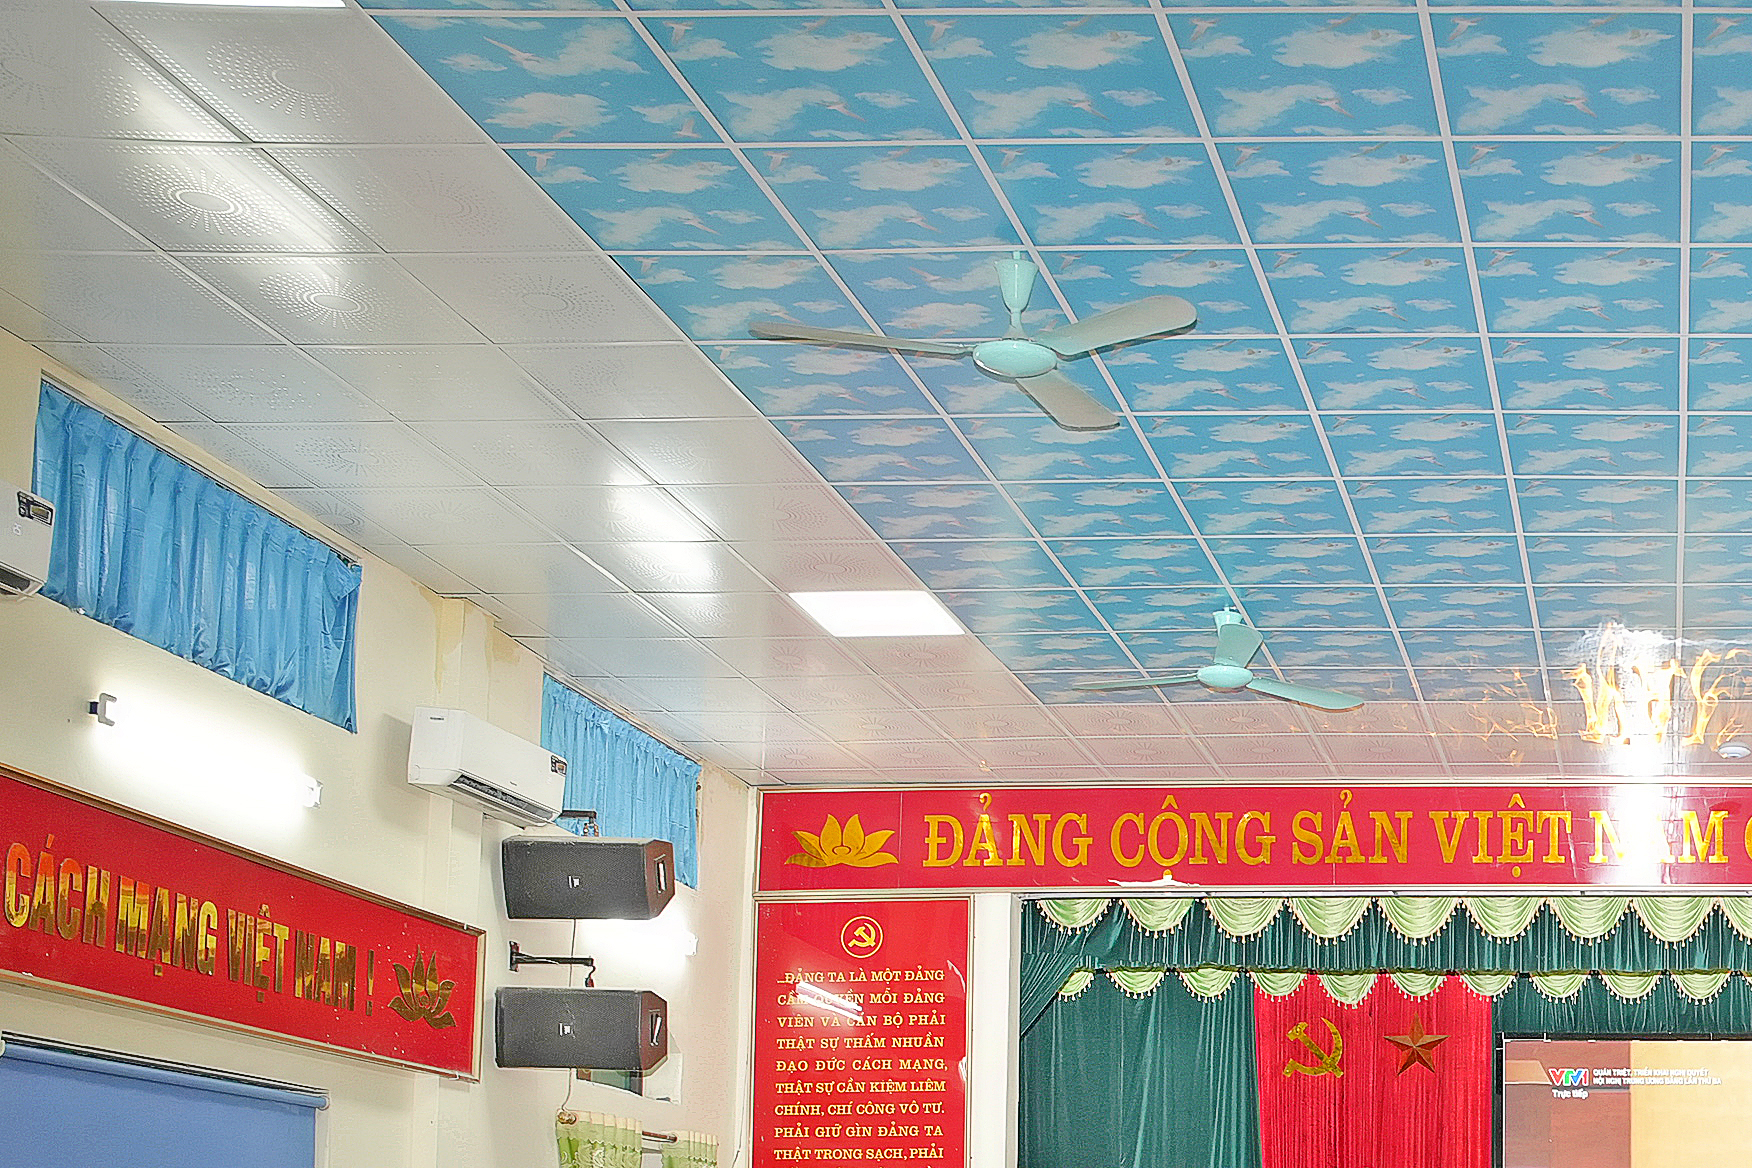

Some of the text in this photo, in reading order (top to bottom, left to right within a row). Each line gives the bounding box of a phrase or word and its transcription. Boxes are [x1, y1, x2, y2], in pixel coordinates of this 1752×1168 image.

[923, 792, 1094, 868] ĐẢNG
[1110, 793, 1276, 880] CỘNG
[1291, 790, 1413, 865] SẢN
[1429, 793, 1572, 877] VIỆT
[1590, 810, 1729, 864] NM
[4, 834, 111, 948] CÁCH
[115, 875, 218, 977] MẠNG
[227, 904, 290, 1002] VIỆT
[294, 929, 357, 1011] NAM
[828, 972, 845, 982] TA
[850, 968, 867, 982] LÀ
[871, 968, 901, 984] MỘT
[905, 965, 944, 981] ĐẢNG
[903, 988, 945, 1003] ĐẢNG
[778, 1013, 814, 1027] VIÊN
[821, 1013, 840, 1026] VÀ
[883, 1012, 903, 1028] BỘ
[908, 1010, 946, 1025] PHẢI
[777, 1032, 944, 1051] THẬT SỰ THẤM NHUẦN
[776, 1056, 948, 1072] ĐẠO ĐỨC CÁCH MẠNG,
[775, 1077, 946, 1095] THẬT SỰ CẦN KIỆM LIÊM
[775, 1101, 945, 1116] CHÍNH, CHÍ CÔNG VÔ TƯ.
[774, 1121, 943, 1138] PHẢI GIỮ GÌN ĐẢNG TA
[774, 1143, 944, 1162] THẬT TRONG SẠCH, PHẢI
